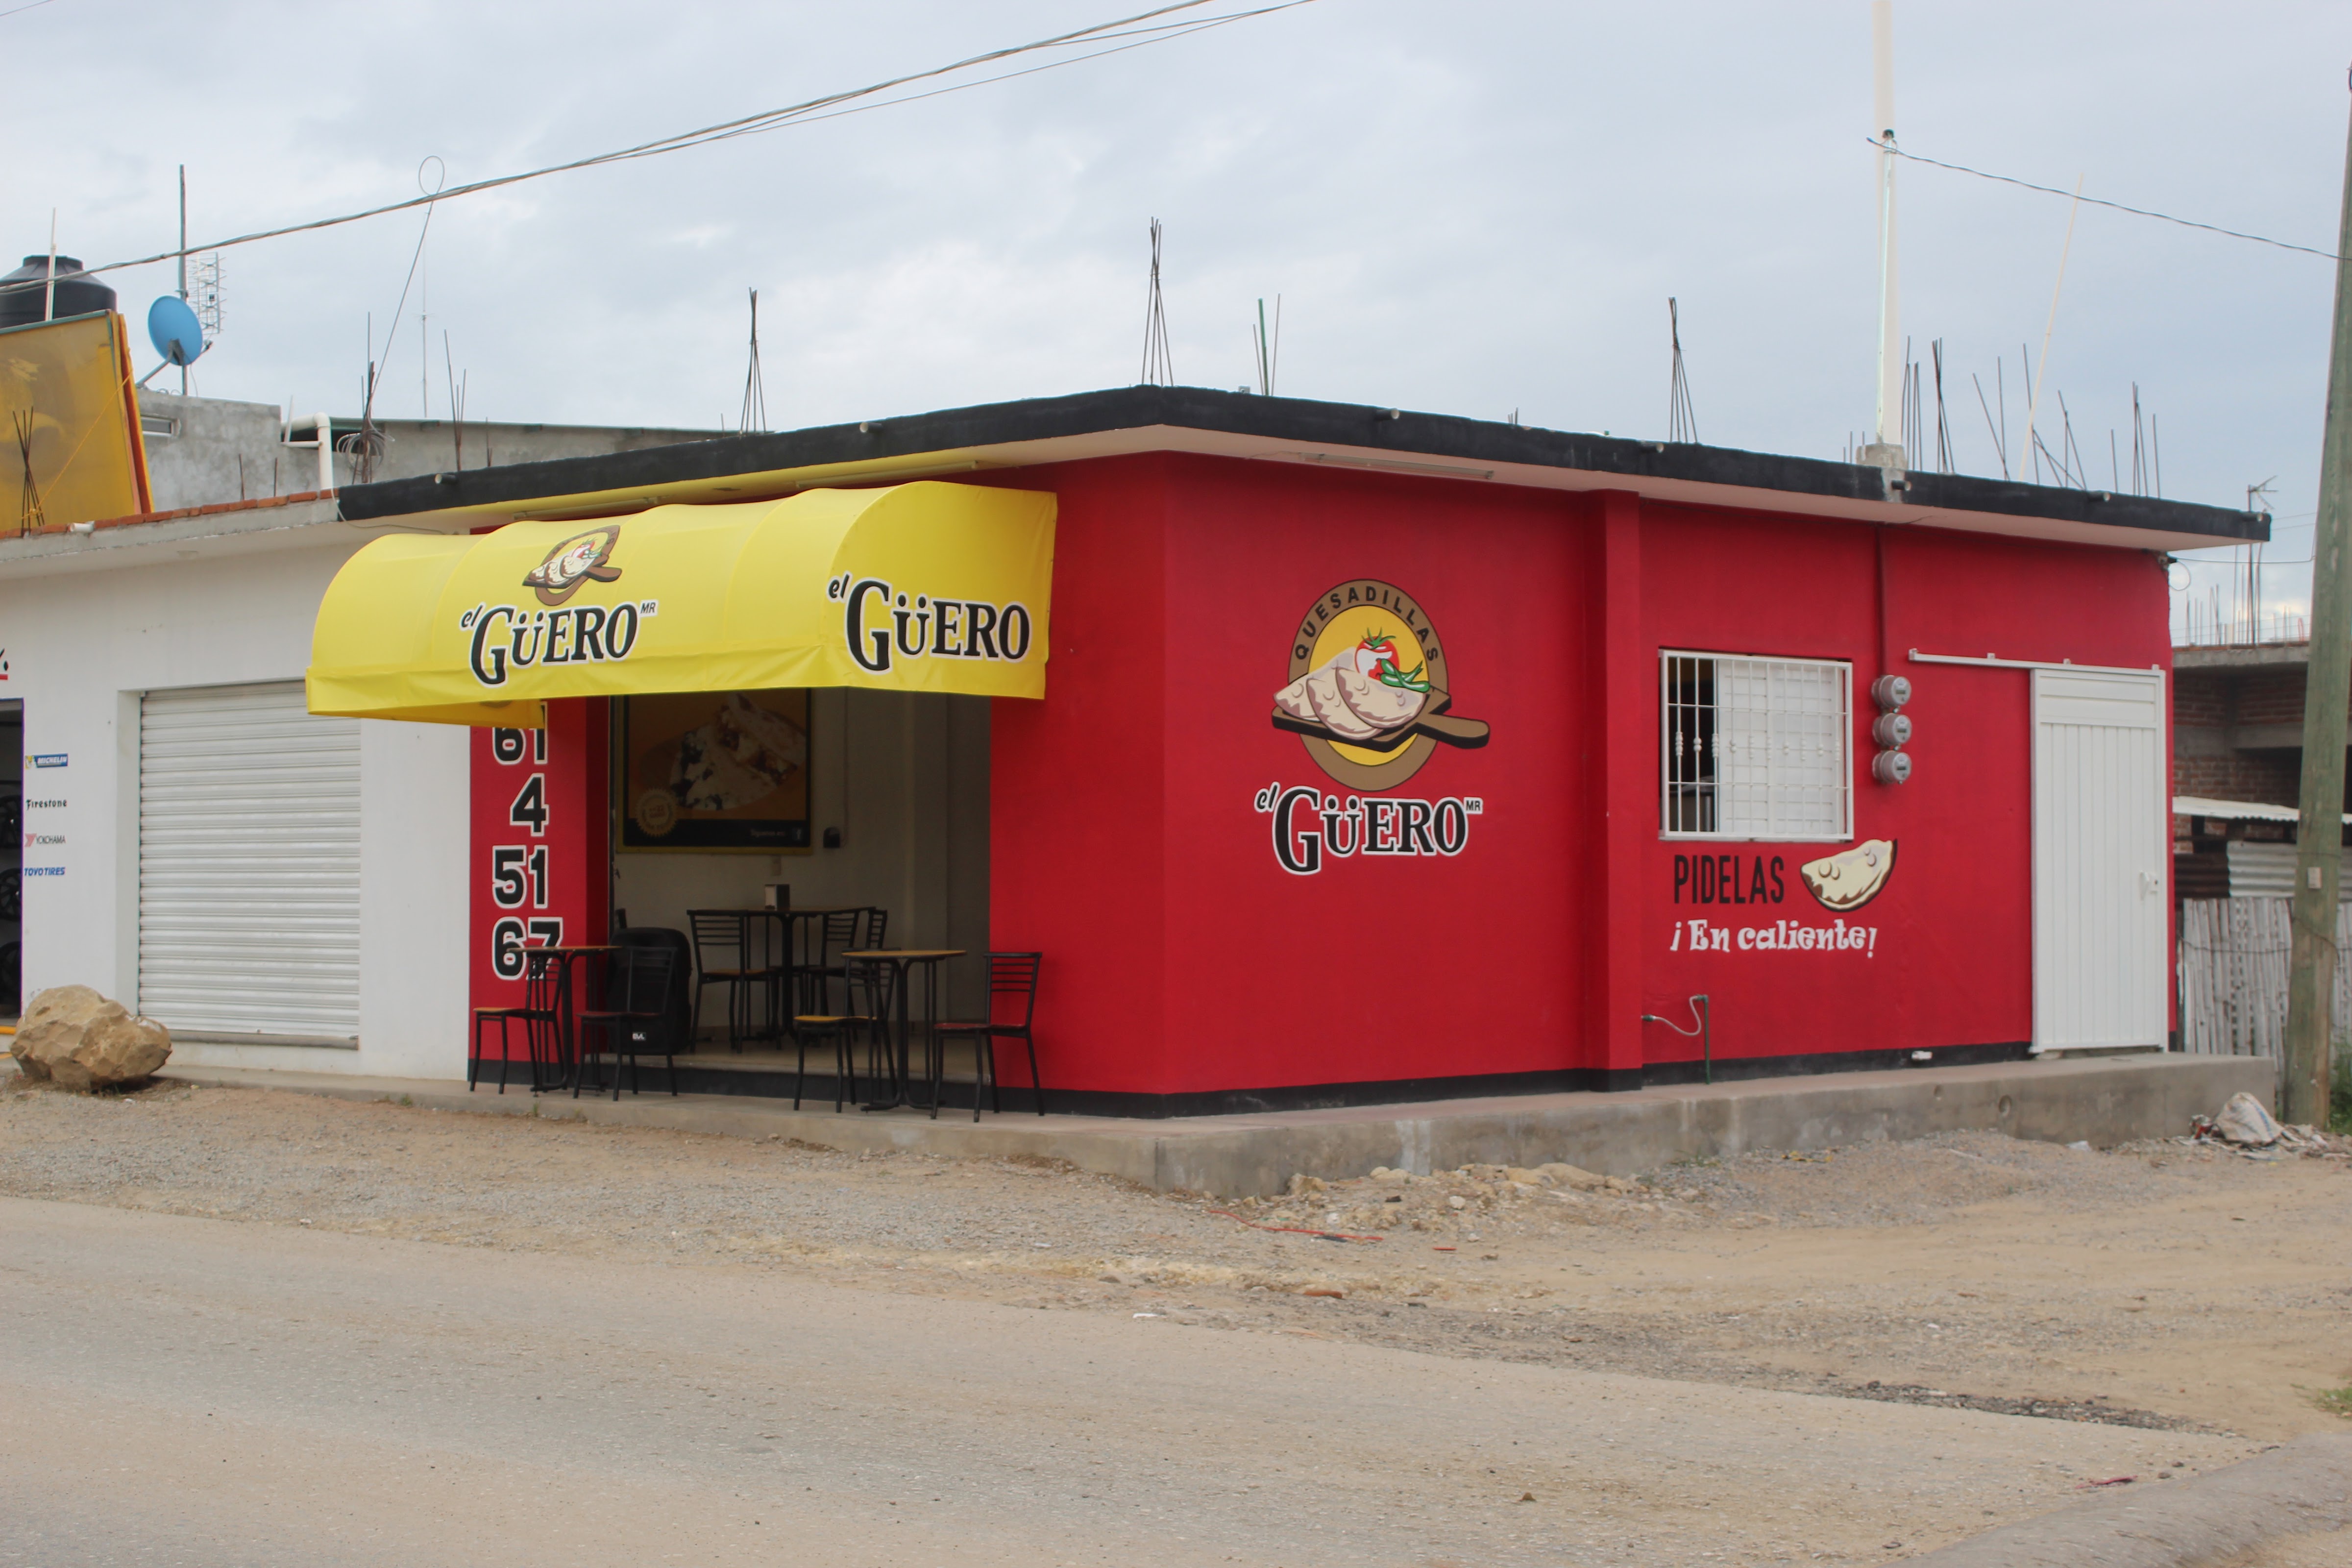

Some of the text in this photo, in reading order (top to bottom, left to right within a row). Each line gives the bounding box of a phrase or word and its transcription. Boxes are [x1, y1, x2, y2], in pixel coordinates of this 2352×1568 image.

[828, 573, 850, 599] el
[461, 605, 483, 628] el
[640, 602, 656, 614] MR
[1295, 586, 1439, 661] QUESADILLAS
[37, 756, 67, 764] MICHELIN
[25, 798, 68, 810] Firestone
[510, 773, 549, 836] 4
[1255, 783, 1278, 811] el
[1465, 799, 1482, 812] MR
[36, 835, 66, 844] YOKOHAMA
[492, 844, 548, 909] 51
[1674, 854, 1784, 904] PIDELAS
[492, 916, 564, 980] 67
[1737, 919, 1878, 958] caliente!
